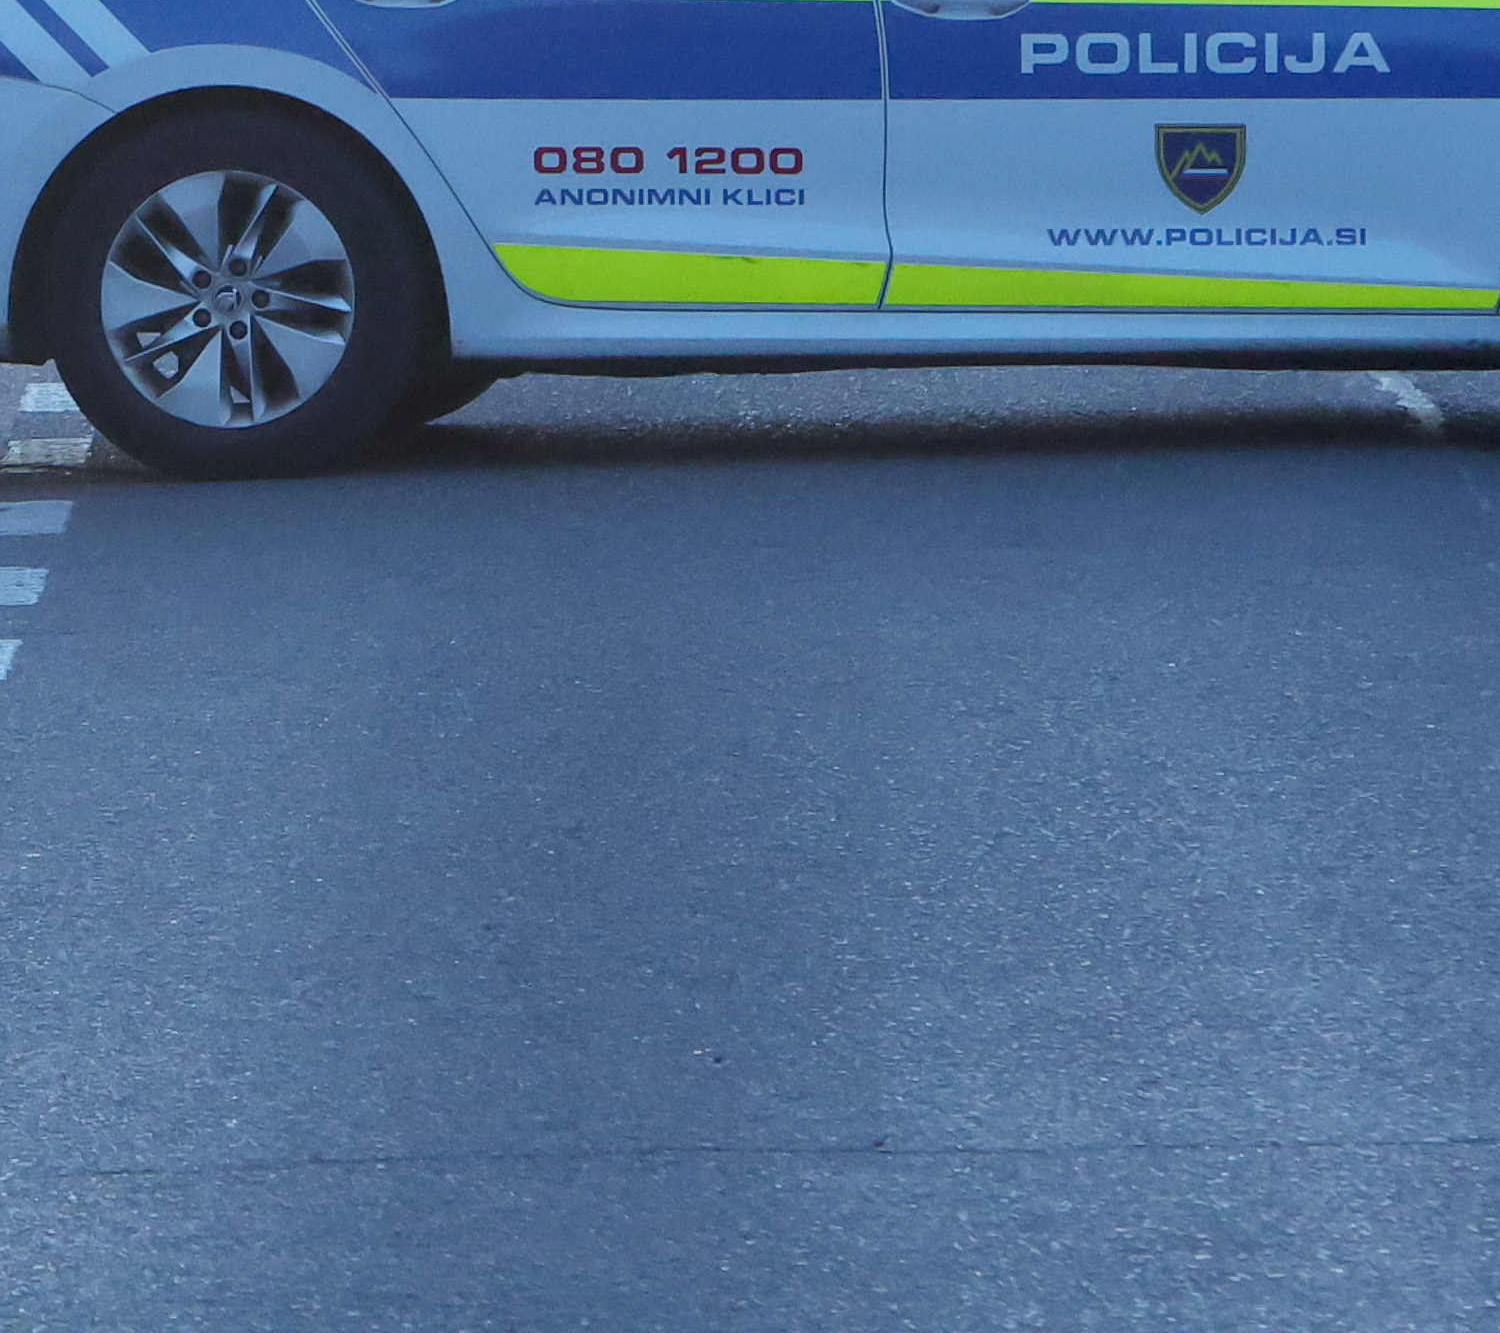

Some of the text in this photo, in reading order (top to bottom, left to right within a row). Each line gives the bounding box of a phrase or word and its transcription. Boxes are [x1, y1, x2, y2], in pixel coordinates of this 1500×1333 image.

[1020, 31, 1392, 75] POLICIJA
[533, 146, 804, 175] 080 1200
[533, 188, 806, 207] ANONIMNI KLICI
[1046, 228, 1368, 248] WWW.POLICIJA.SI
